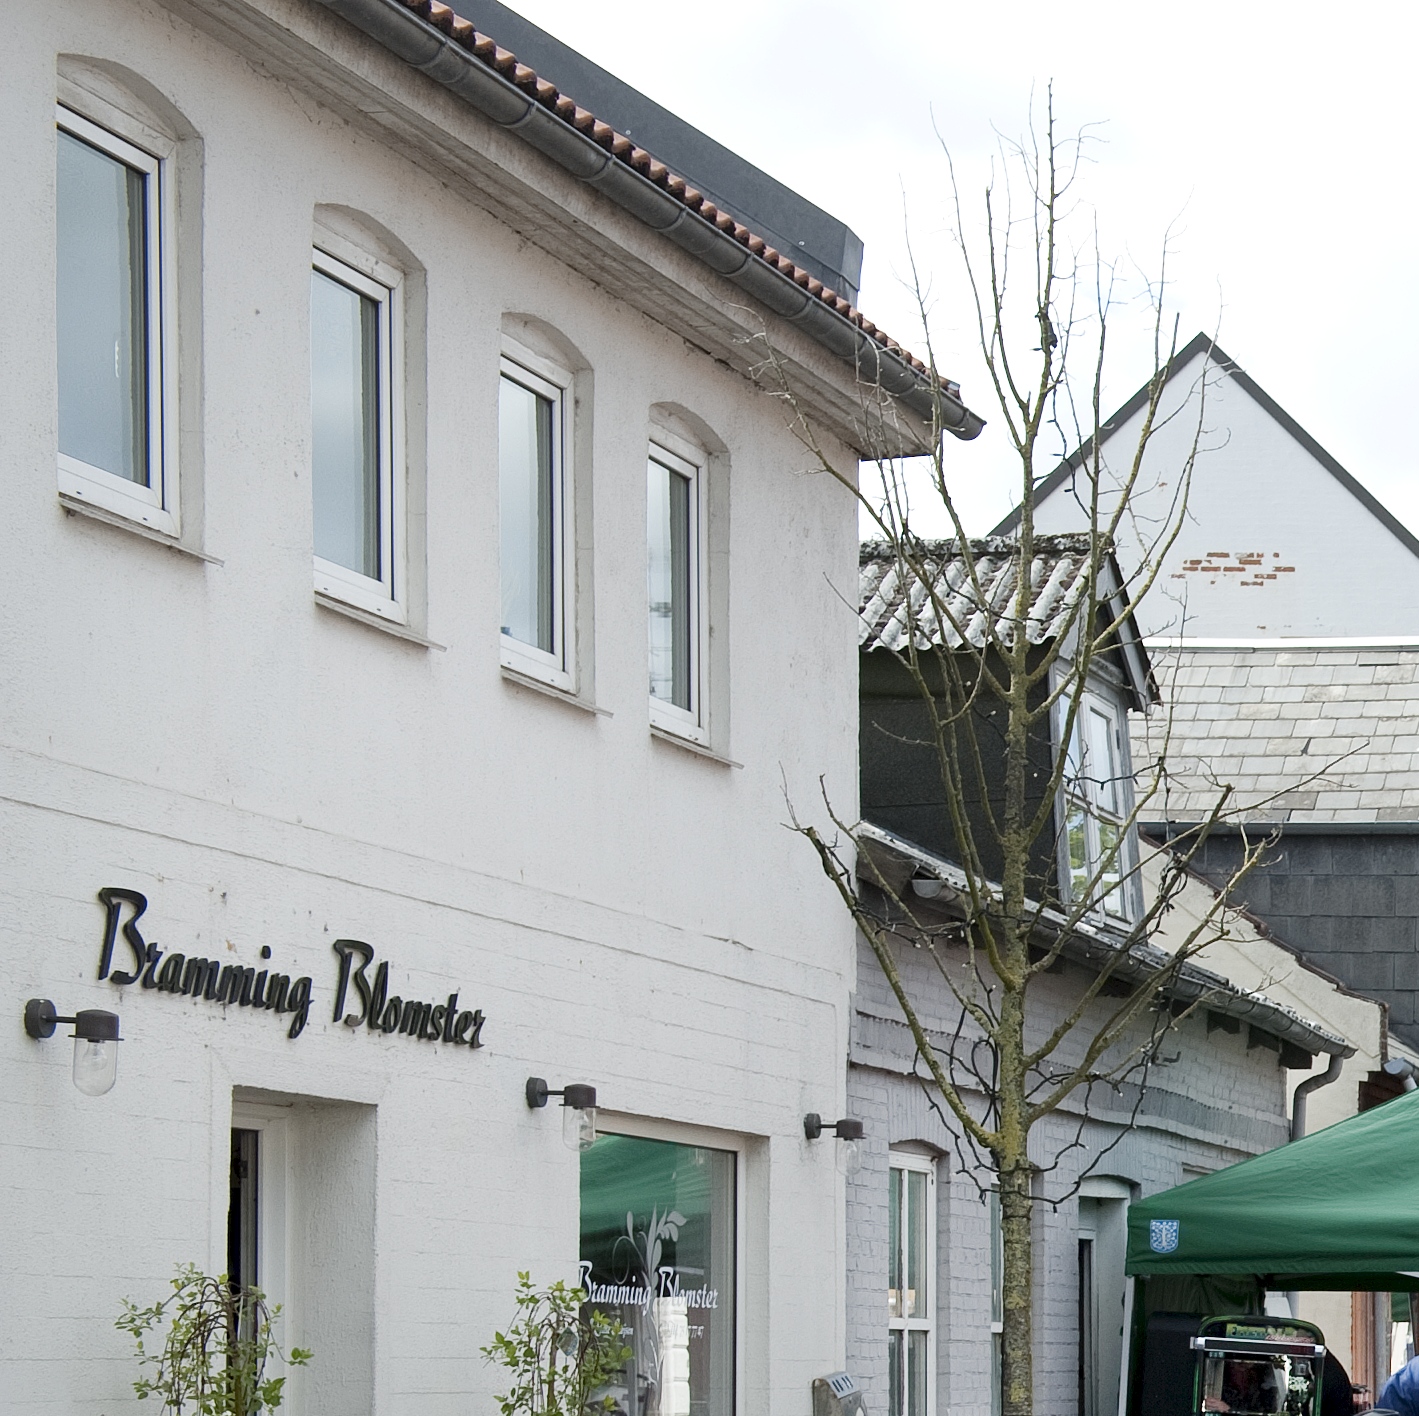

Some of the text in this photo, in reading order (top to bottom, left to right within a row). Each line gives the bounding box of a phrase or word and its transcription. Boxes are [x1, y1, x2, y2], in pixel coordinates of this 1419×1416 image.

[98, 887, 487, 1049] Bramming Blomster
[579, 1261, 719, 1316] Bramming Blomster
